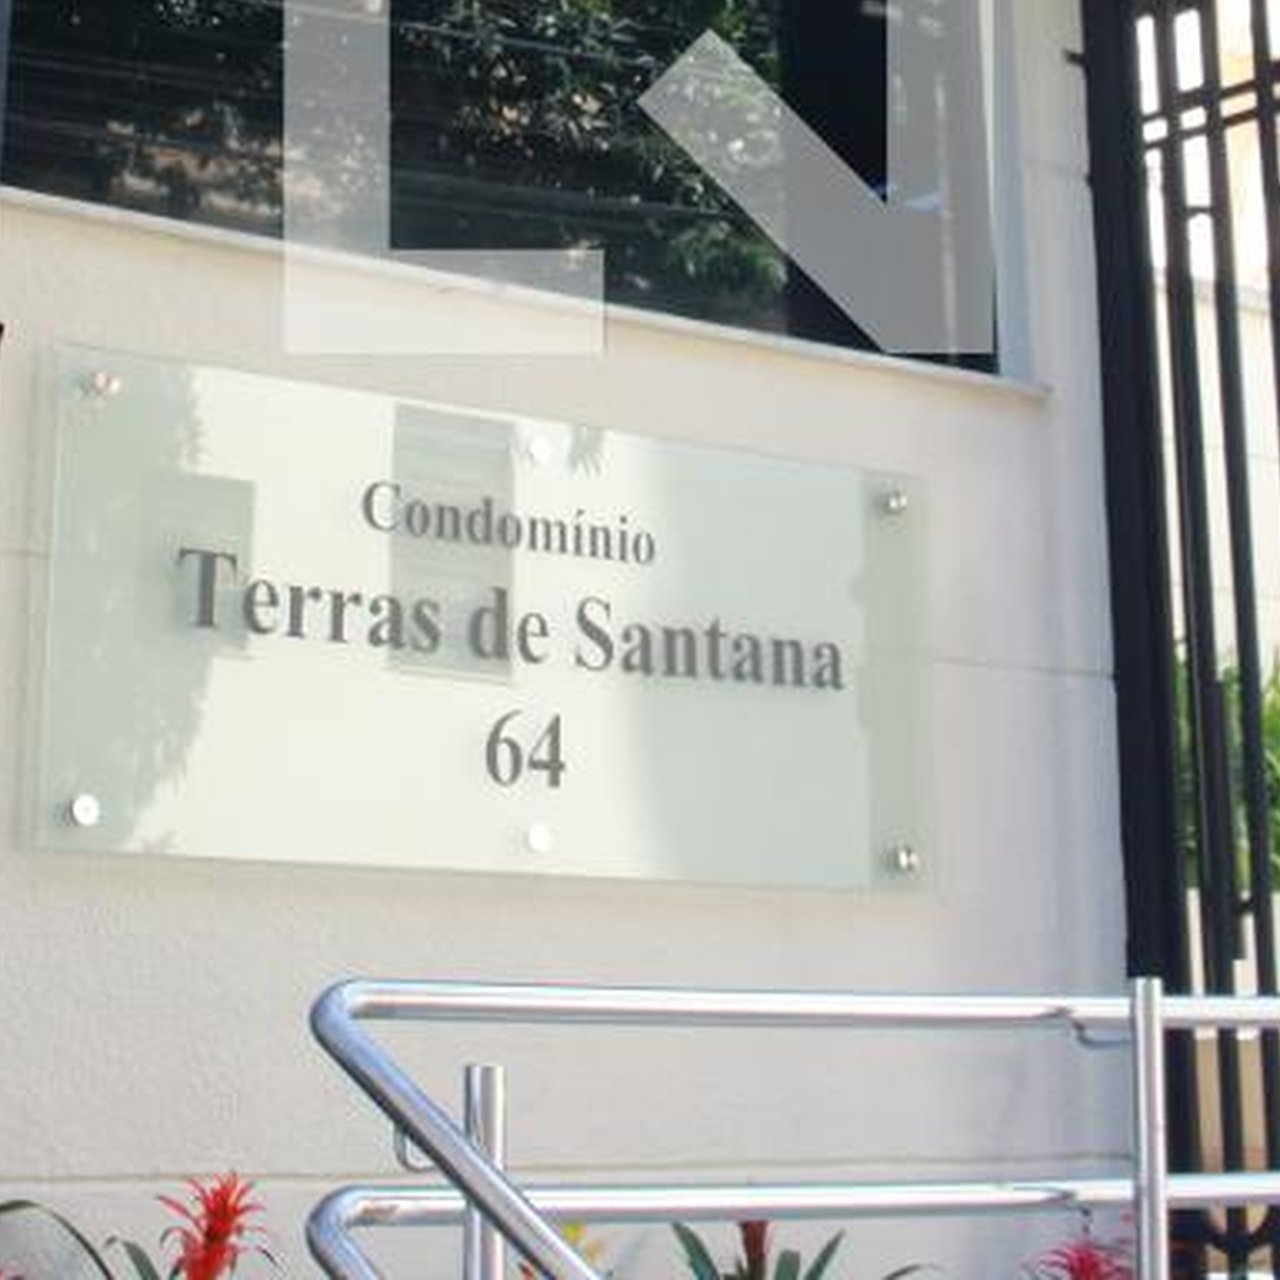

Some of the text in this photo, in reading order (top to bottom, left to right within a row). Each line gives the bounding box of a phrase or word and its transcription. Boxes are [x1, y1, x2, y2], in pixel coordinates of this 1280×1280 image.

[361, 479, 657, 566] Condomínio
[178, 548, 844, 692] Terras de Santana
[484, 709, 566, 789] 64
